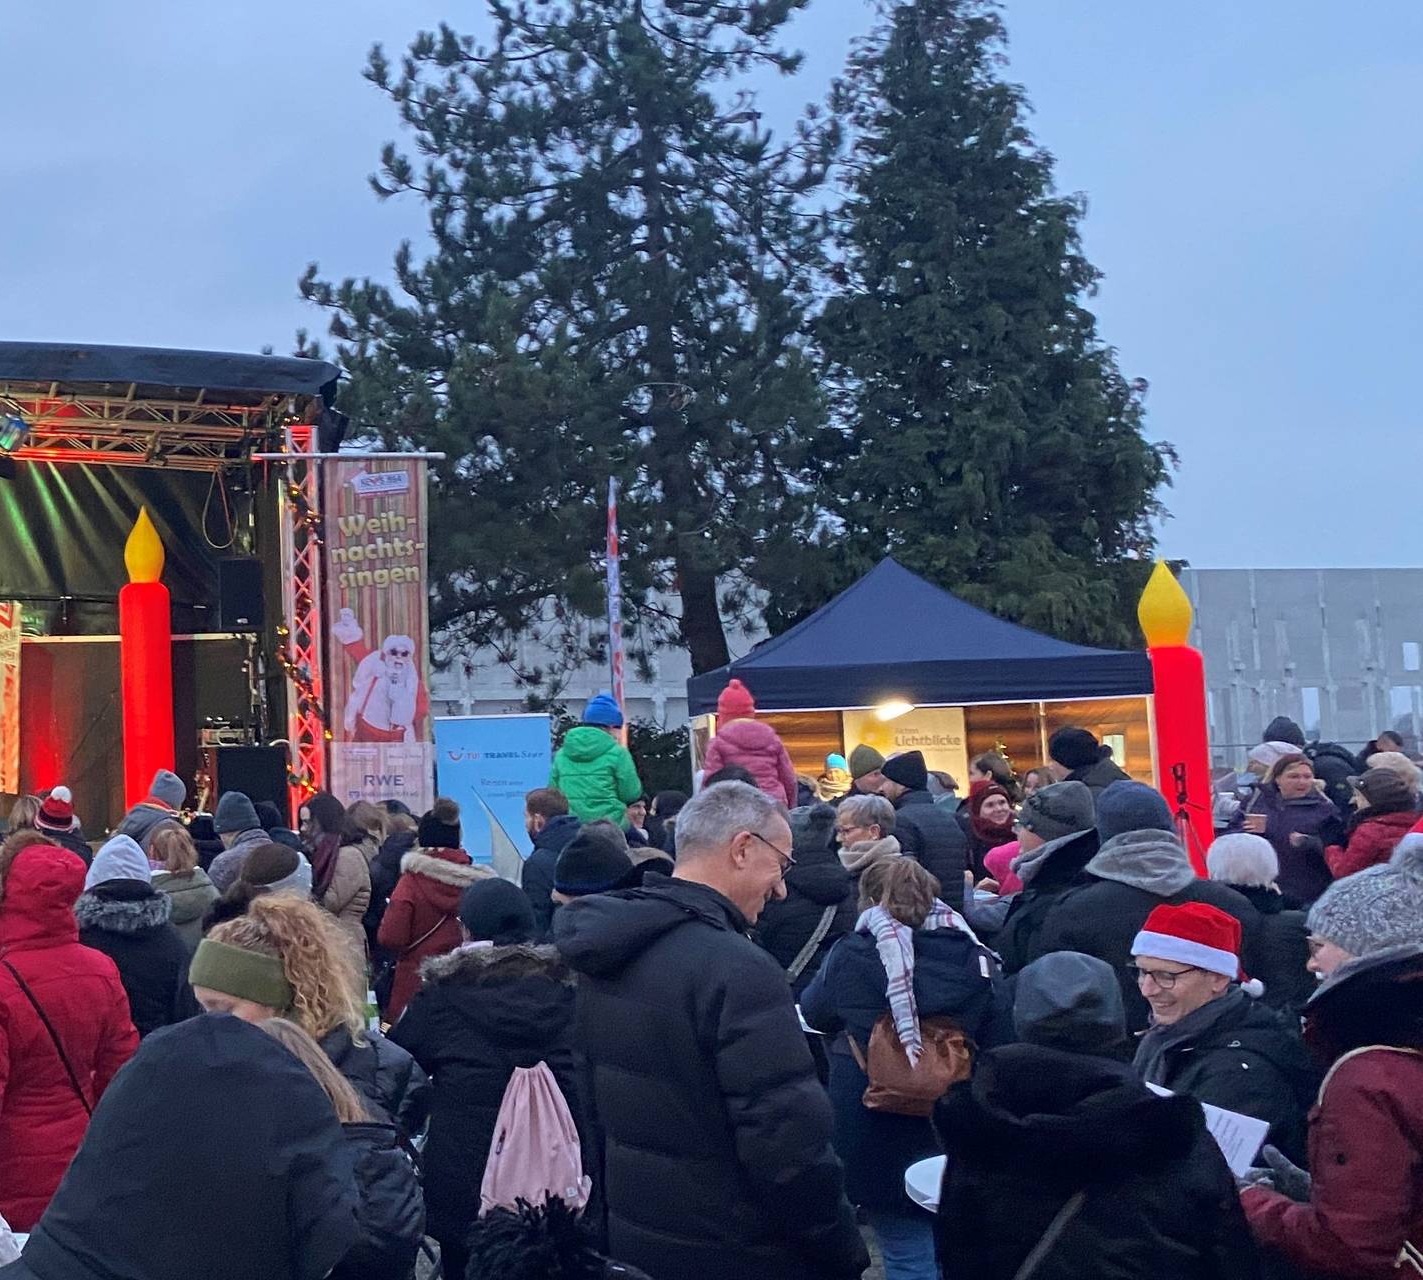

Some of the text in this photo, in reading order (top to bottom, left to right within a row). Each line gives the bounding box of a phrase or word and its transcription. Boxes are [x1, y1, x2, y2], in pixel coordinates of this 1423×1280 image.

[337, 511, 417, 537] Weih-
[331, 537, 426, 564] nachts-
[338, 566, 420, 589] singen
[894, 734, 961, 746] Lichtblicke
[363, 774, 404, 786] RWE
